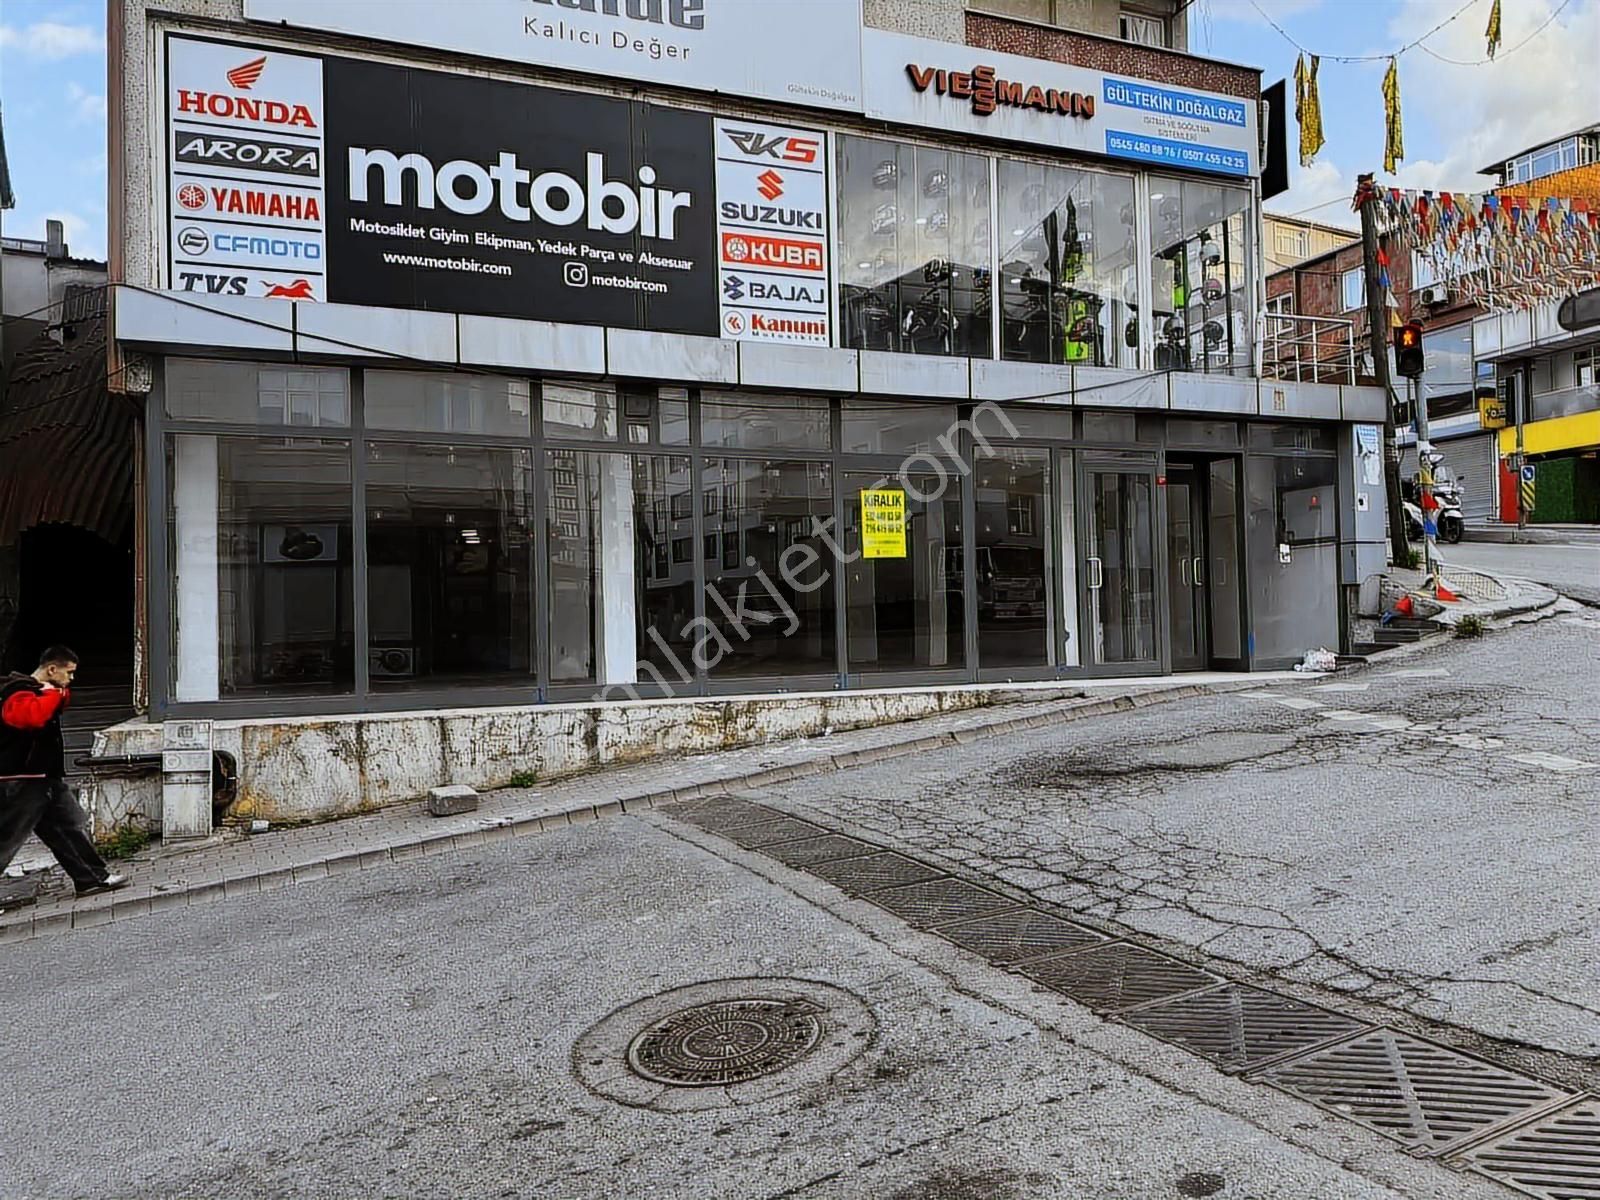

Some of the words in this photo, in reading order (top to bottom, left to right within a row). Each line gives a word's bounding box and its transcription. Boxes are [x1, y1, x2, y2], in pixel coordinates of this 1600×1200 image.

[524, 16, 599, 45] Kalıcı
[613, 31, 690, 60] Değer
[177, 89, 317, 128] HONDA
[906, 64, 1095, 119] VIESSMANN
[1106, 85, 1173, 111] GÜLTEKİN
[1176, 99, 1244, 123] DOĞALGAZ
[178, 137, 318, 171] ARORA
[721, 128, 819, 163] RKS
[211, 186, 320, 221] YAMAHA
[349, 146, 691, 240] motobir
[721, 201, 822, 230] SUZUKI
[214, 234, 320, 259] CFMOTO
[350, 218, 426, 239] Motosiklet
[429, 227, 469, 245] Giyim
[475, 232, 535, 253] Ekipman,
[537, 239, 577, 256] Yedek
[580, 244, 615, 263] Parça
[618, 251, 634, 263] ve
[638, 252, 693, 271] Aksesuar
[750, 241, 822, 267] KUBA
[383, 252, 512, 276] www.motobir.com
[179, 272, 249, 296] TVS
[592, 274, 668, 293] motobircom
[749, 282, 825, 304] BAJAJ
[751, 313, 826, 335] Kanuni
